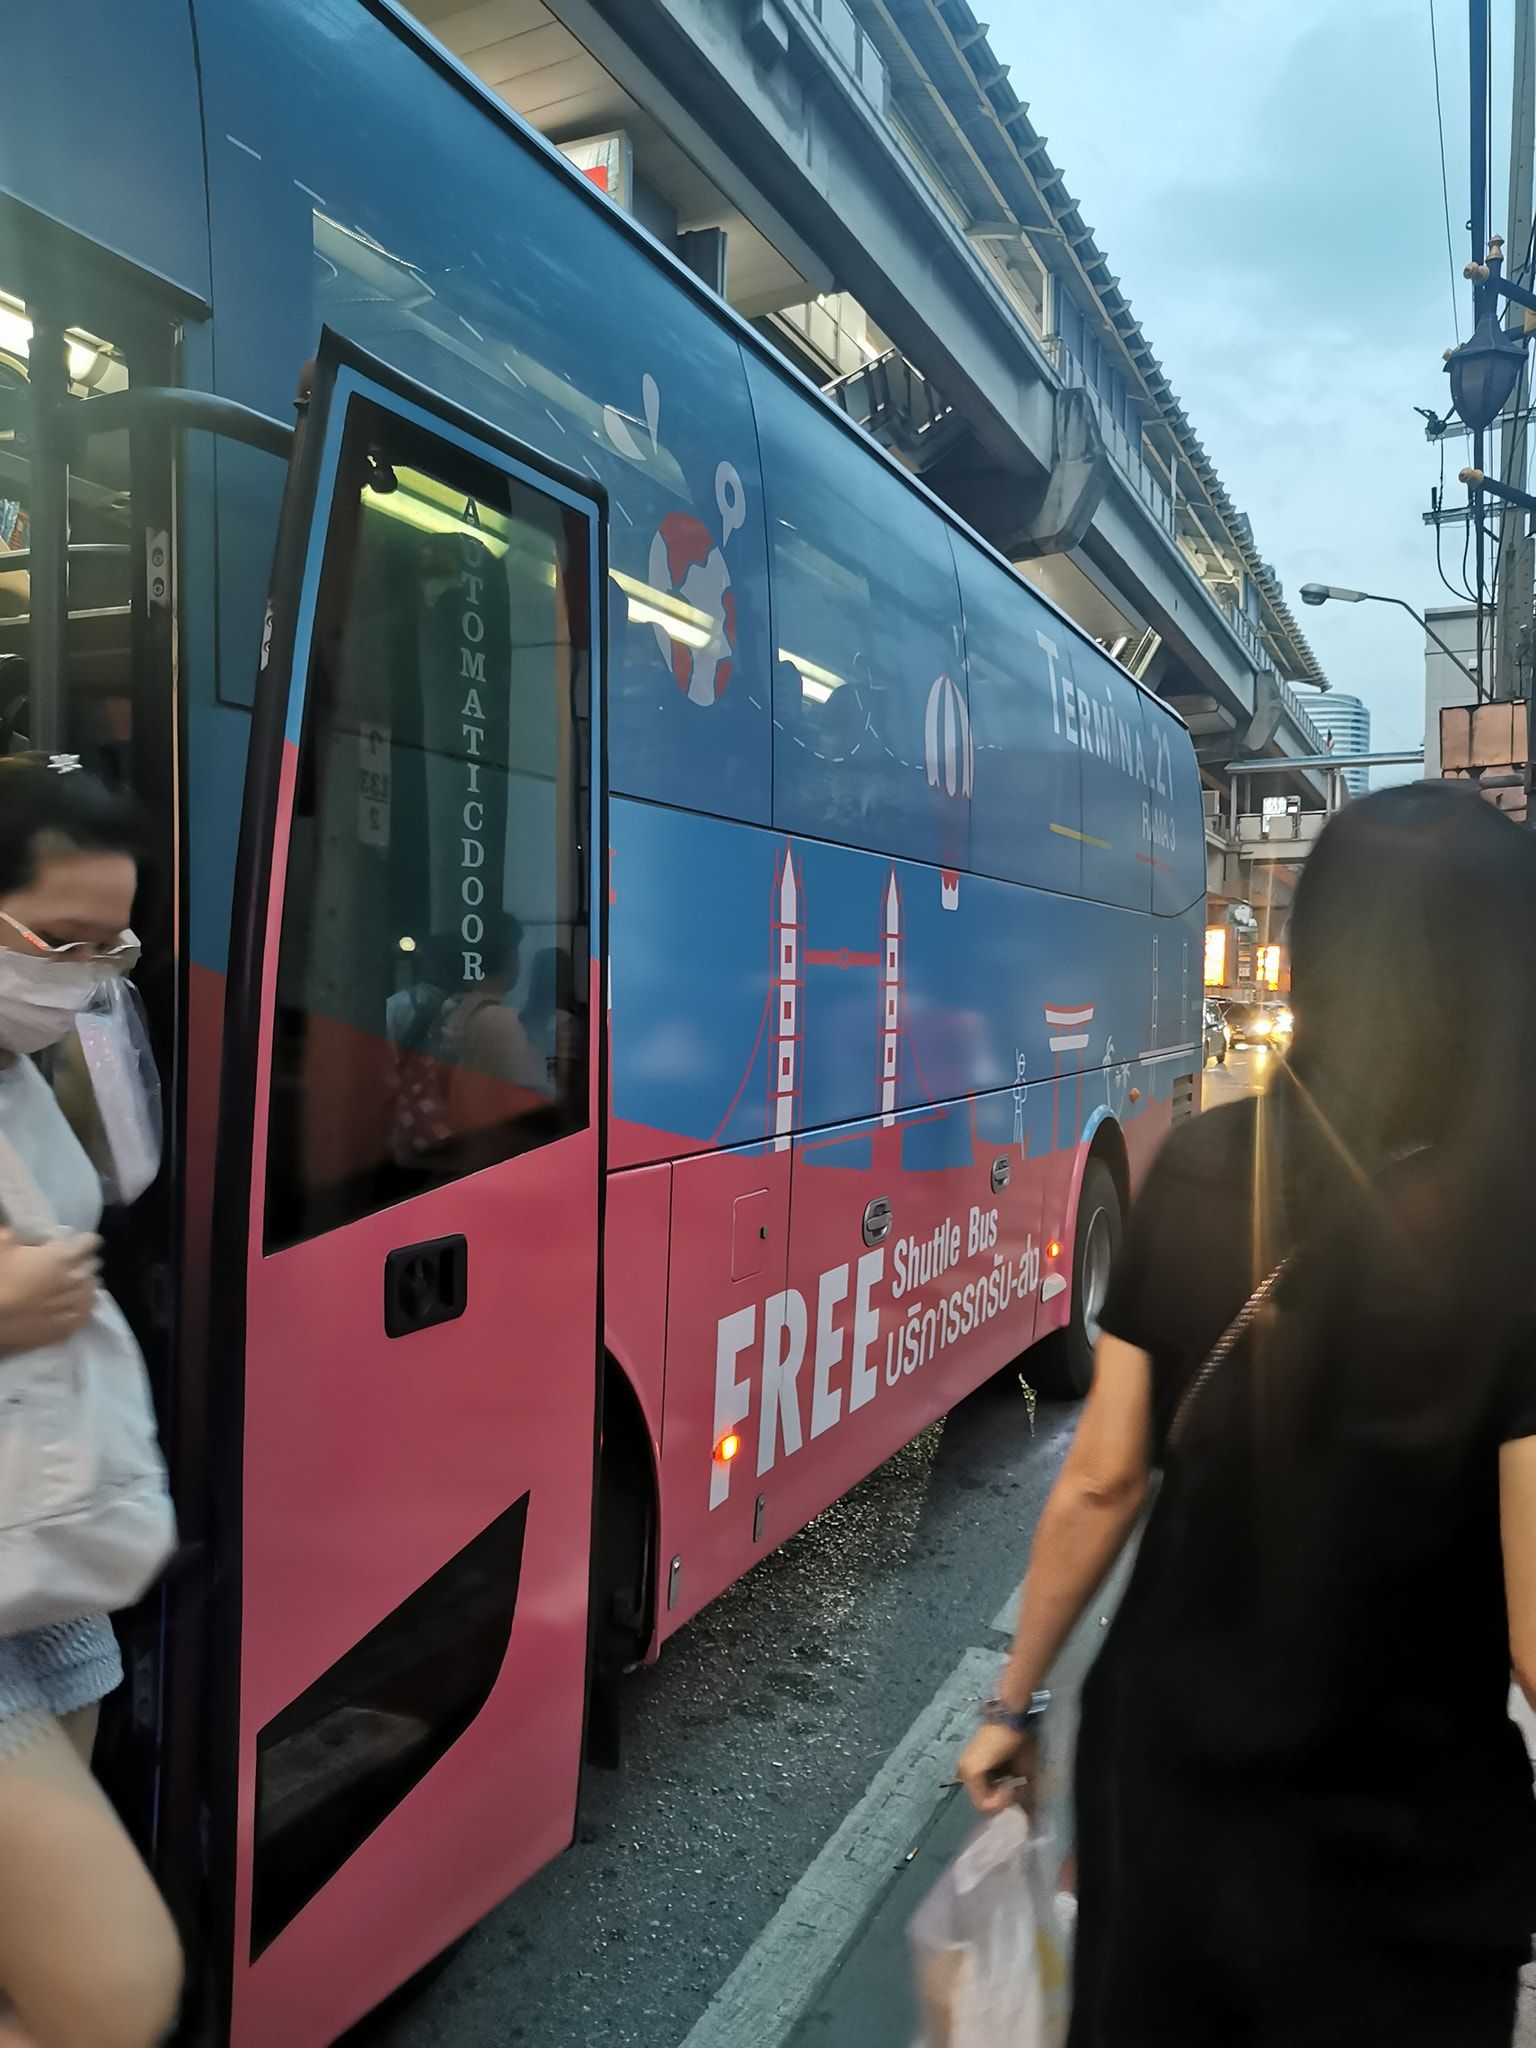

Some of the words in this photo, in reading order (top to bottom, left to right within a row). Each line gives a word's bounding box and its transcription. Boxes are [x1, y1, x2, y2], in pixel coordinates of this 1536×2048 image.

[1036, 630, 1155, 789] TERMiNA
[886, 1233, 1040, 1387] บริการรถรับ-ส่ง
[891, 1217, 961, 1299] Shuttle
[968, 1206, 998, 1257] Bus
[709, 1248, 884, 1511] FREE
